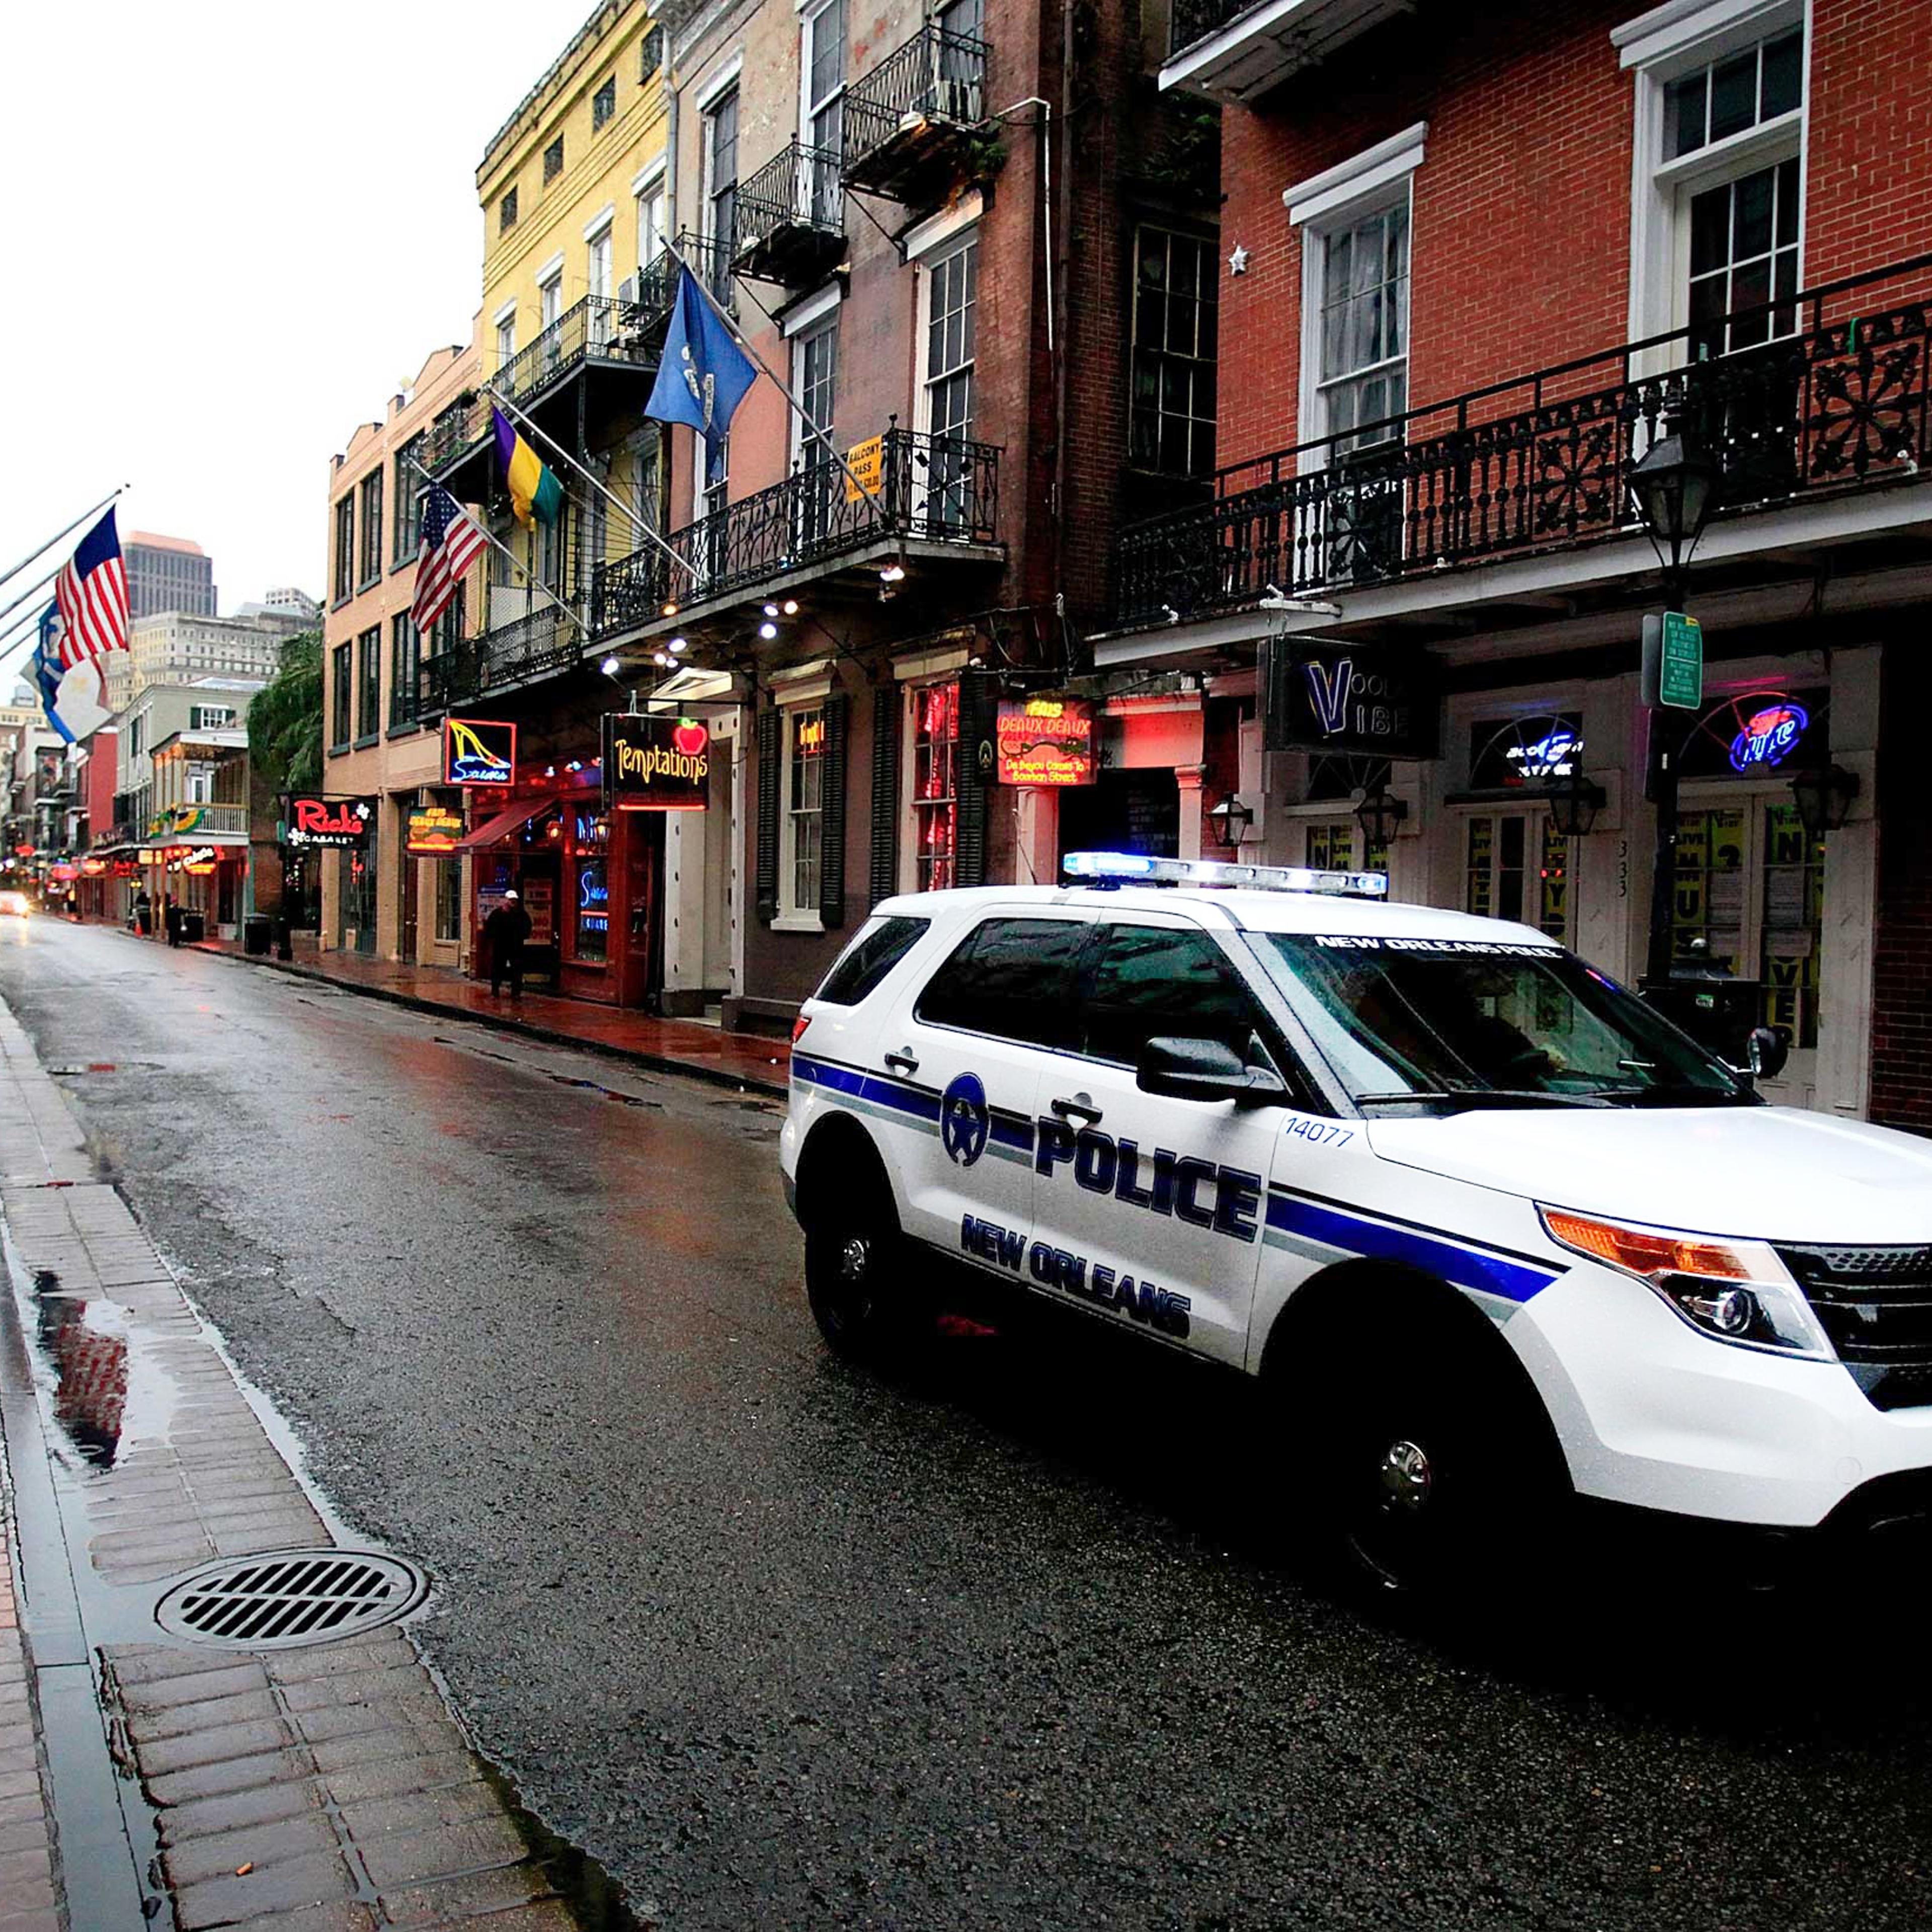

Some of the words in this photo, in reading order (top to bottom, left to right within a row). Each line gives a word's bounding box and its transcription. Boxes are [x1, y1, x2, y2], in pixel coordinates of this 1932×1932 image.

[1000, 716, 1043, 734] DEAUX
[1045, 719, 1092, 735] DEAUX
[614, 738, 708, 786] Temptations
[1315, 935, 1380, 948] NEW
[1384, 938, 1501, 954] ORLEANS
[1286, 1117, 1354, 1148] 14077
[1035, 1115, 1262, 1243] POLICE
[961, 1213, 1027, 1272] NEW
[1029, 1241, 1191, 1340] ORLEANS
